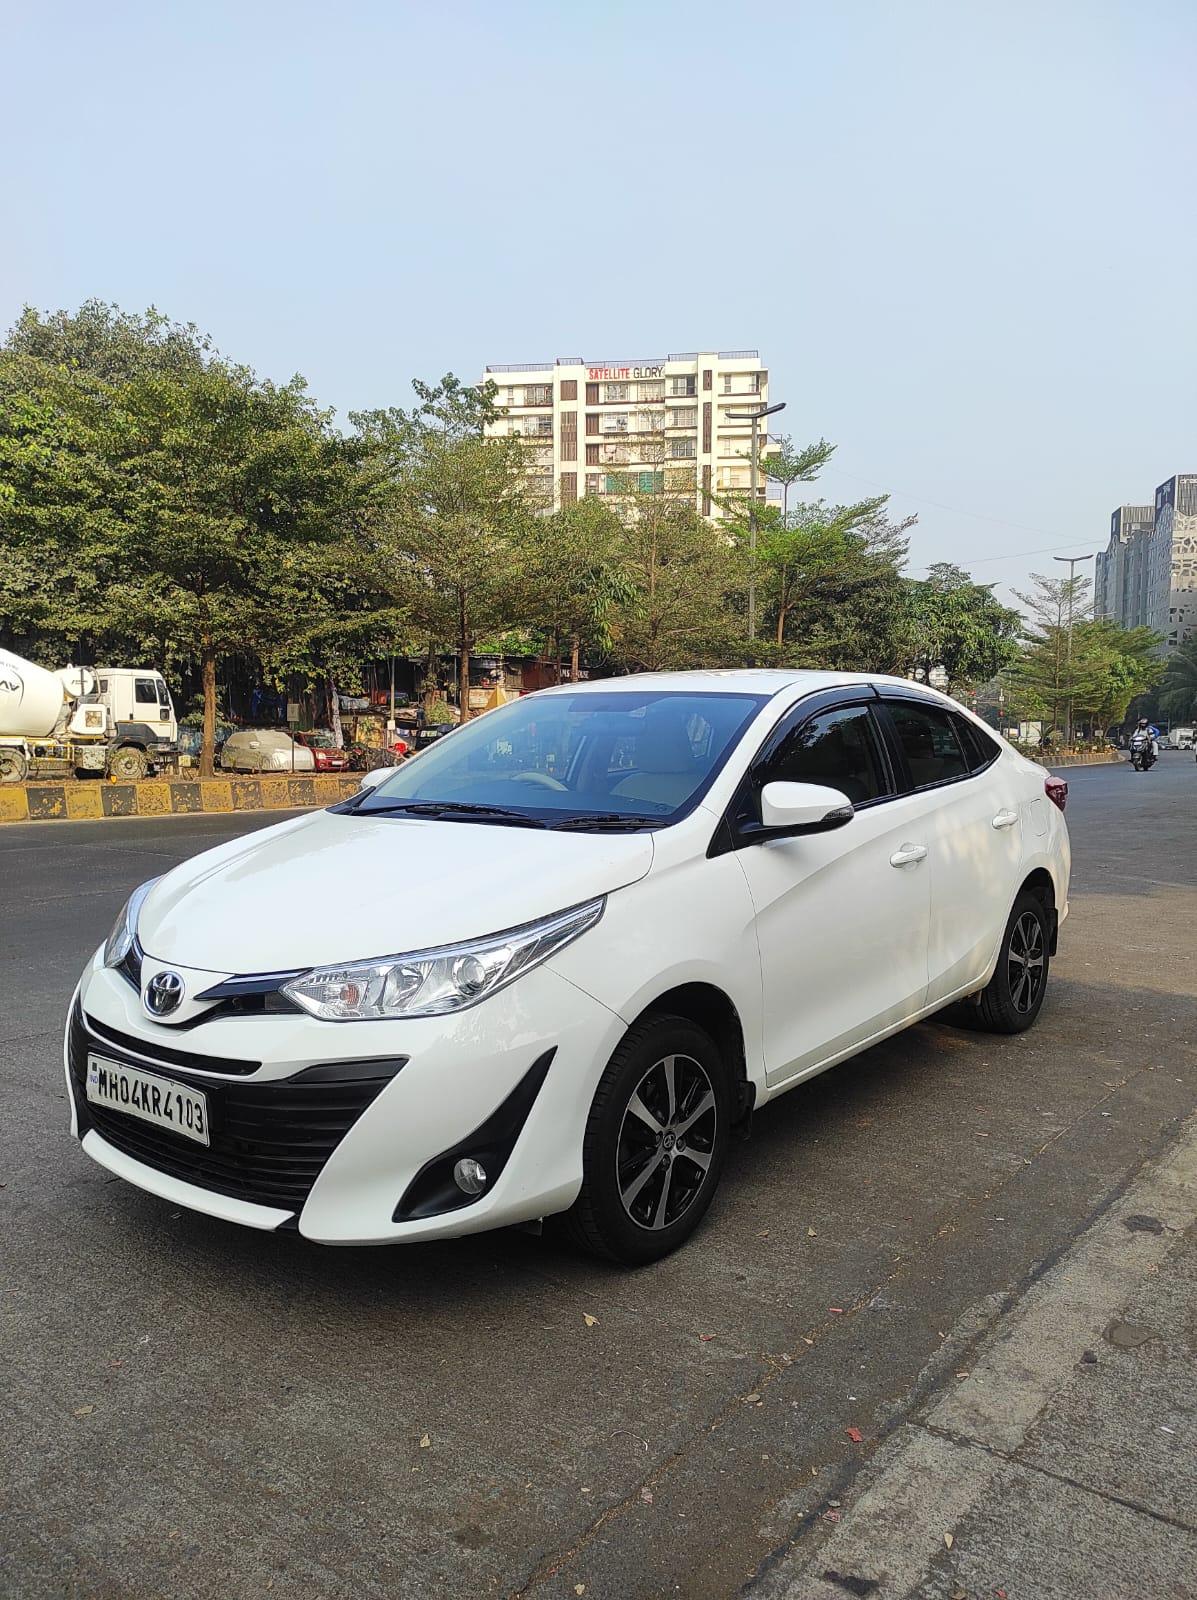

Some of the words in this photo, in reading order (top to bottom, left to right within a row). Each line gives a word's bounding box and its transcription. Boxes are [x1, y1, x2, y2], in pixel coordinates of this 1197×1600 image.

[589, 368, 630, 380] SATELLITE
[633, 366, 663, 379] GLORY
[98, 1067, 204, 1134] MH04KR4103
